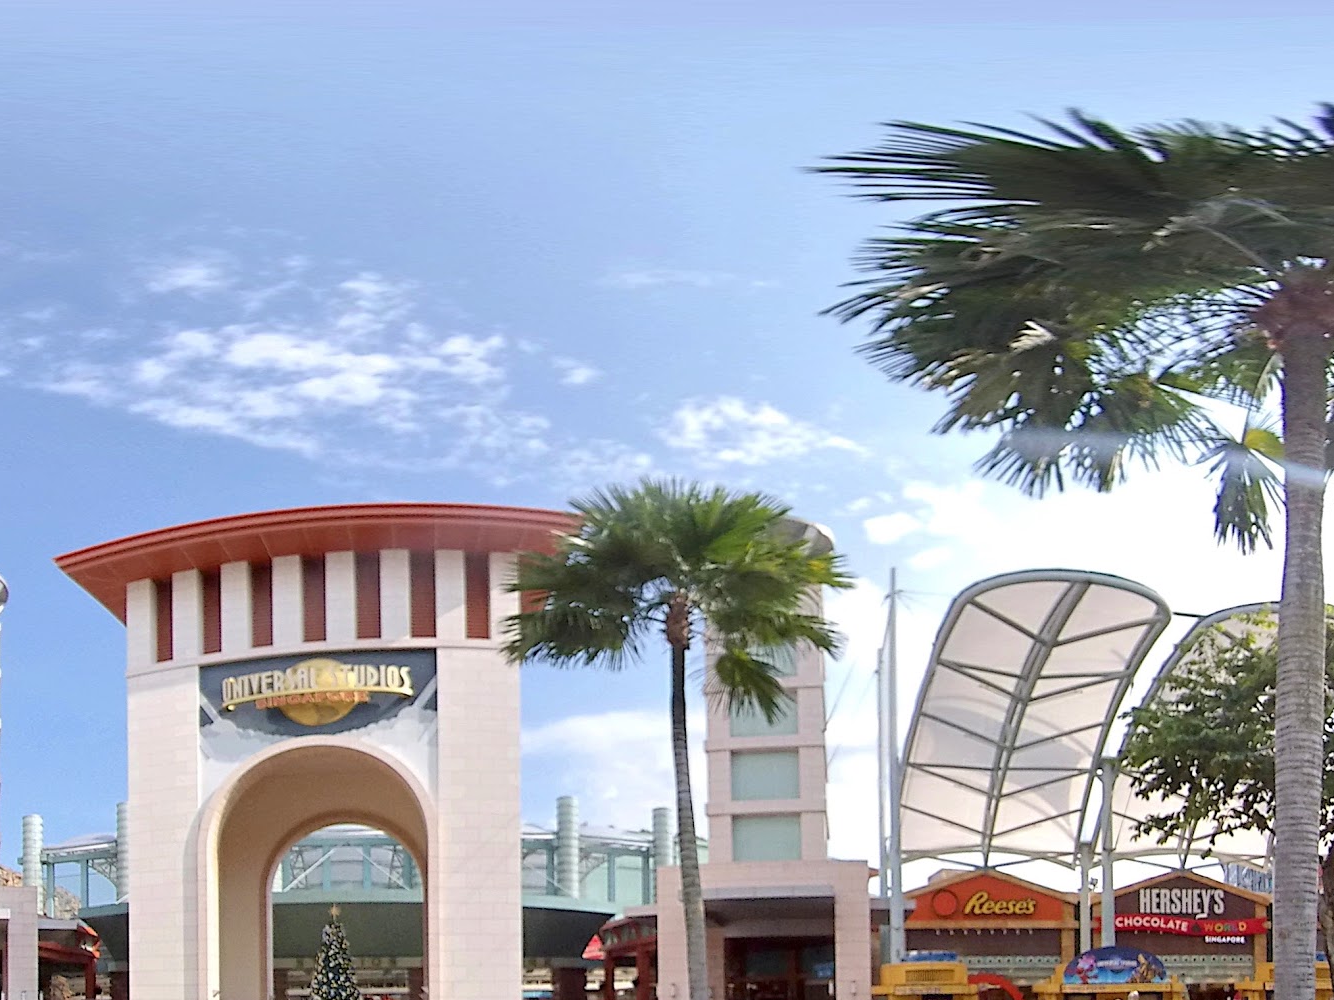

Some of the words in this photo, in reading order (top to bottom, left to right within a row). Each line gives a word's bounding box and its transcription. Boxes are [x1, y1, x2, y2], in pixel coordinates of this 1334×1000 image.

[222, 667, 318, 702] UNIVERSAL
[326, 664, 412, 688] STUDIOS
[255, 691, 370, 709] SINGAPORE
[964, 891, 1037, 915] Reese's
[1139, 888, 1225, 920] HERSHEY'S
[1115, 916, 1188, 932] CHOCOLATE
[1204, 922, 1247, 932] WORLD
[1204, 936, 1247, 944] SINGAPORE
